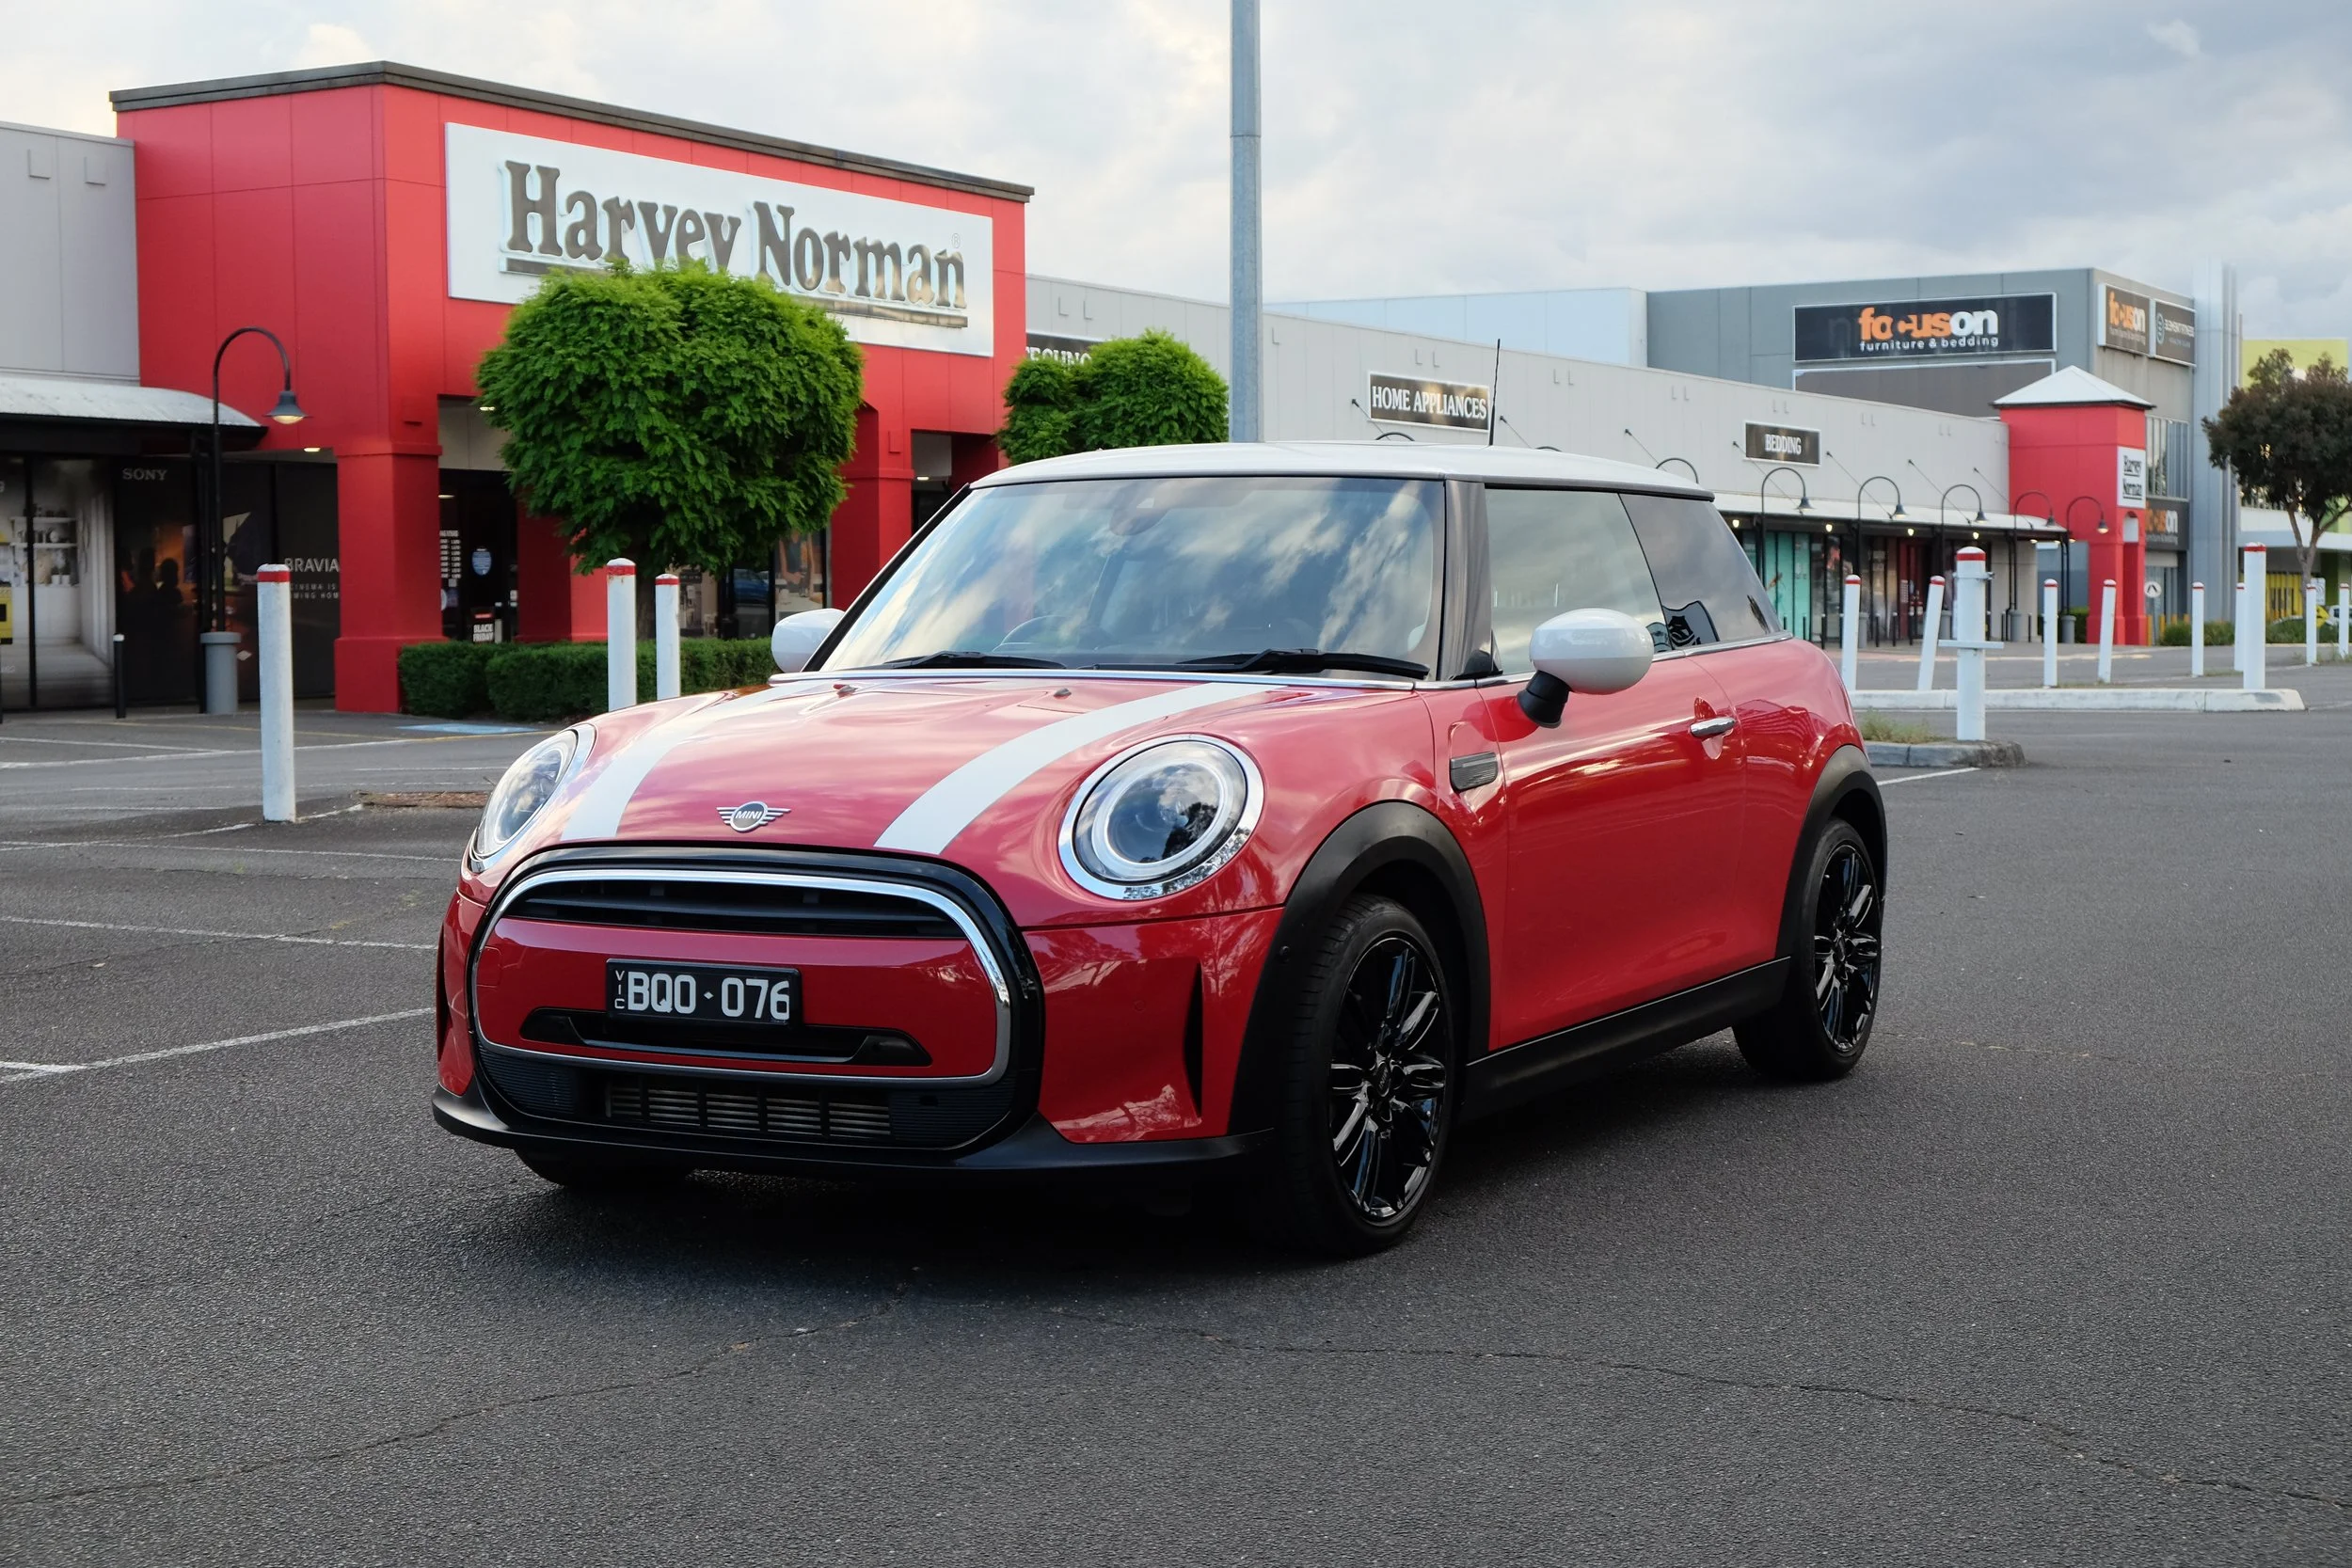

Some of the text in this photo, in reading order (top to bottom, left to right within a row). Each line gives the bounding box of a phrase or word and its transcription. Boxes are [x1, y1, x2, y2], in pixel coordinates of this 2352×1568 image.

[504, 159, 966, 309] Harvey Norman
[1859, 335, 1999, 353] furniture & bedding
[1372, 386, 1487, 420] HOME APPLIANCES
[1764, 434, 1802, 455] BEDDING
[122, 467, 167, 481] SONY
[284, 557, 340, 573] BRAVIA
[473, 623, 494, 634] BLACK
[473, 632, 494, 642] FRIDAY
[735, 811, 763, 819] MINI
[614, 970, 625, 1009] VIC
